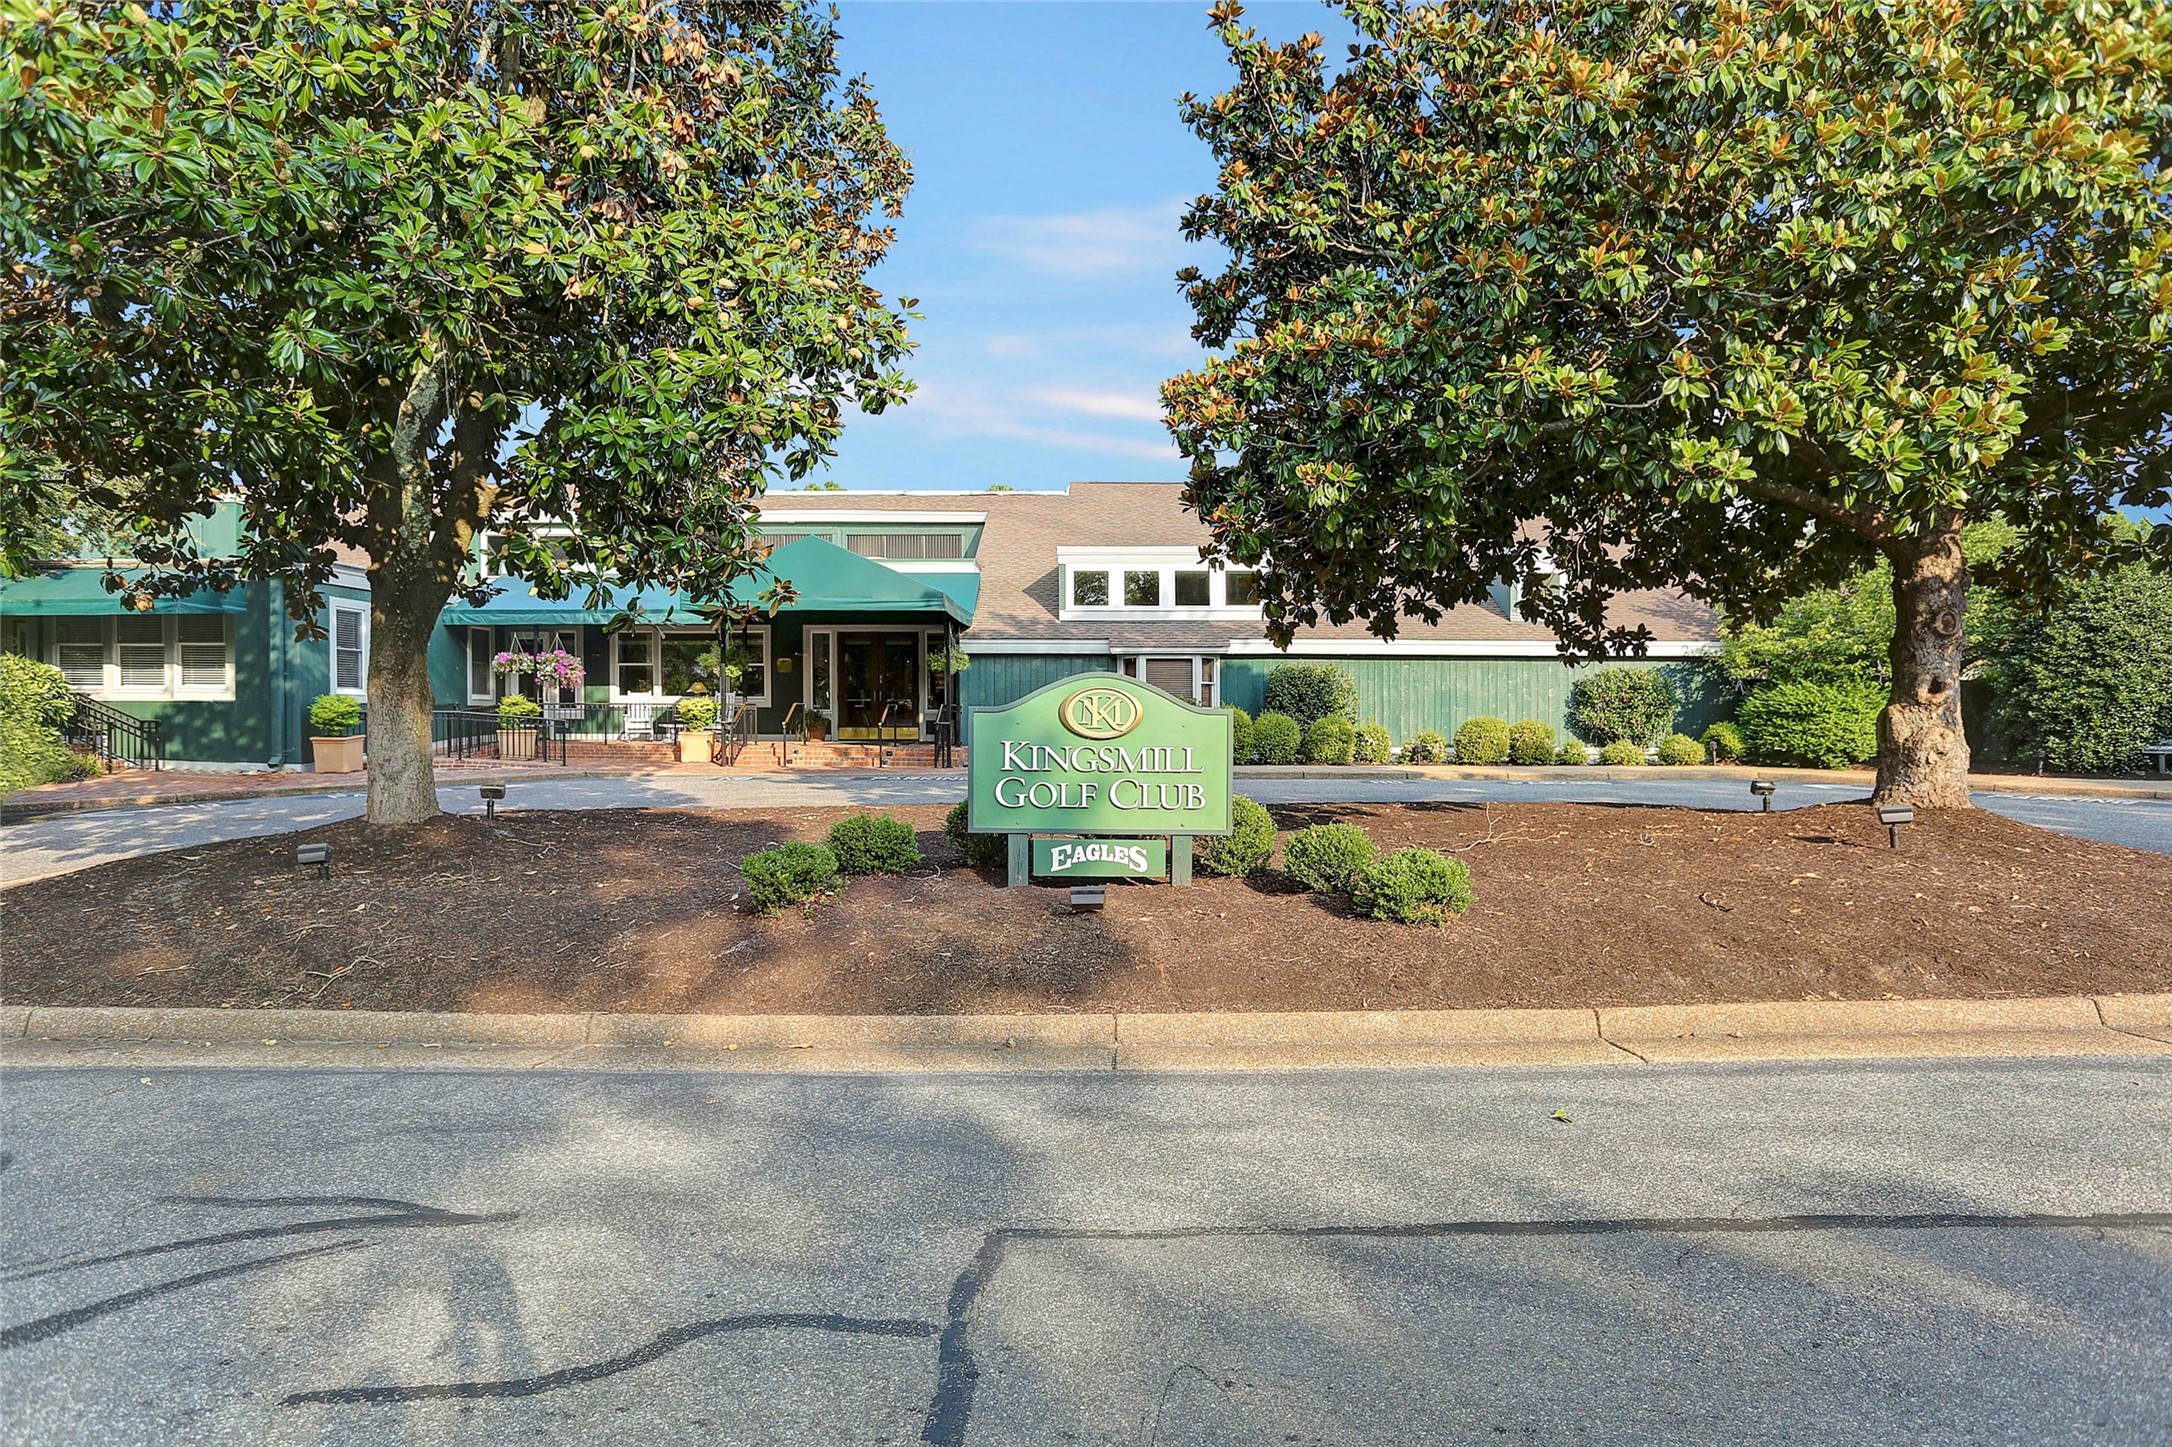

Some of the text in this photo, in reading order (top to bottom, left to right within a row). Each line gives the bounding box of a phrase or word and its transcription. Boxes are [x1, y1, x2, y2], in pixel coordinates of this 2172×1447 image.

[1000, 740, 1205, 773] KINGSMILL
[995, 776, 1207, 810] GOLF CLUB
[1050, 843, 1149, 873] EAGLES
